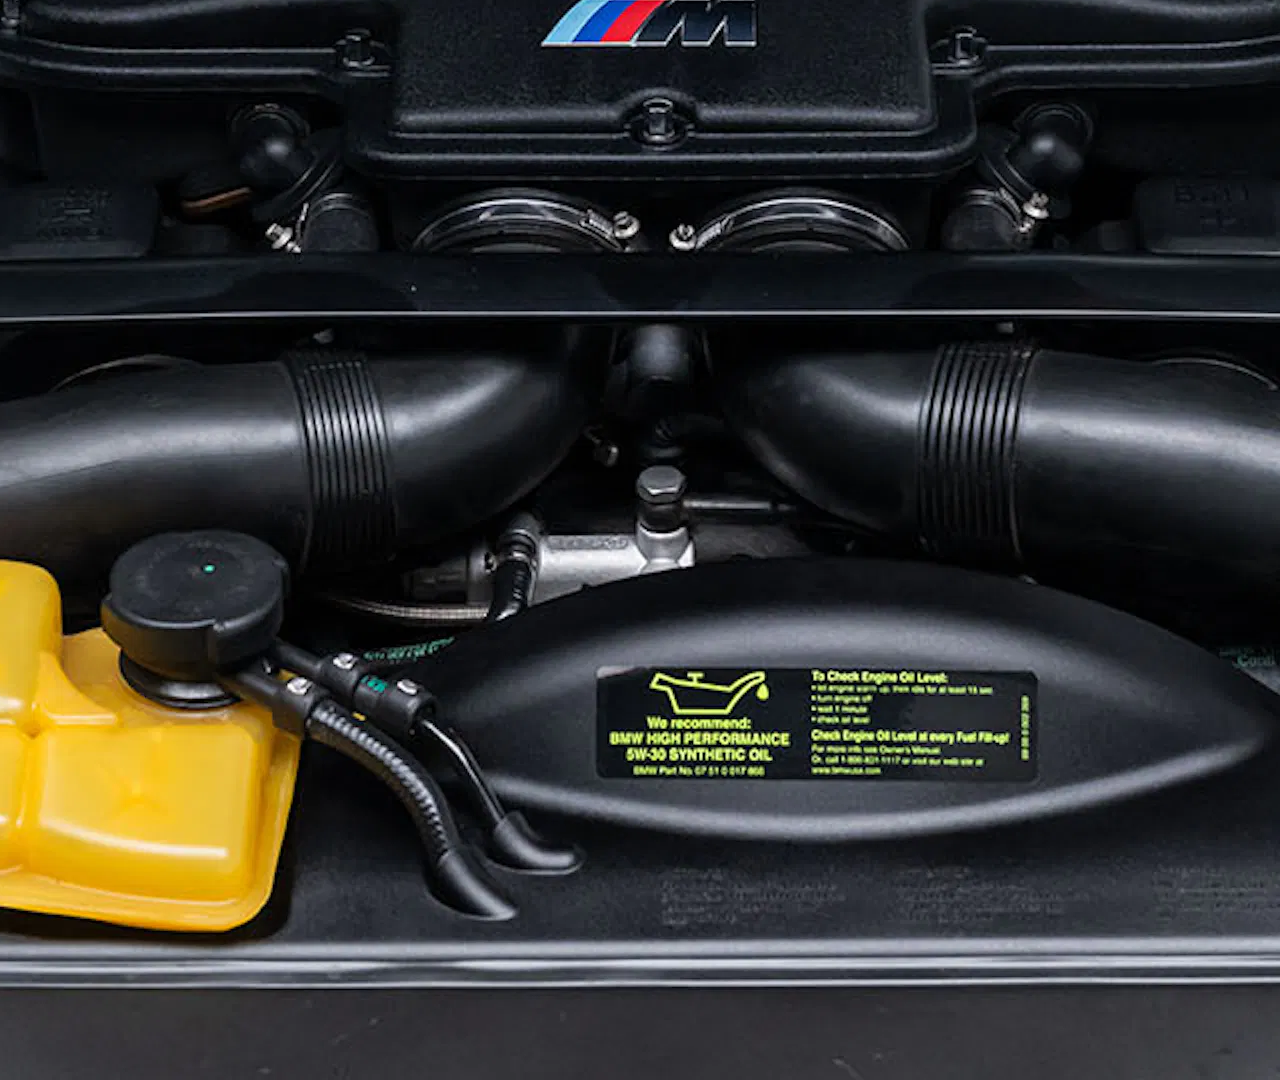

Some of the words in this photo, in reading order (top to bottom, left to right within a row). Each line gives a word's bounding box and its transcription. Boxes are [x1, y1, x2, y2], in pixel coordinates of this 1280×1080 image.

[811, 670, 825, 682] To
[827, 670, 860, 682] Check
[861, 671, 899, 685] Engine
[899, 671, 915, 683] Oil
[917, 672, 949, 684] Level:
[646, 716, 667, 729] We
[670, 717, 752, 730] recommend:
[609, 732, 643, 745] BMW
[646, 732, 681, 745] HIGH
[683, 732, 791, 747] PERFORMANCE
[811, 729, 841, 741] Check
[842, 730, 875, 744] Engine
[876, 730, 891, 742] Oil
[892, 730, 917, 742] Level
[919, 731, 928, 742] at
[929, 732, 954, 745] every
[956, 731, 977, 743] Fuel
[626, 747, 667, 762] 5W-30
[669, 747, 746, 762] SYNTHETIC
[748, 748, 773, 762] OIL
